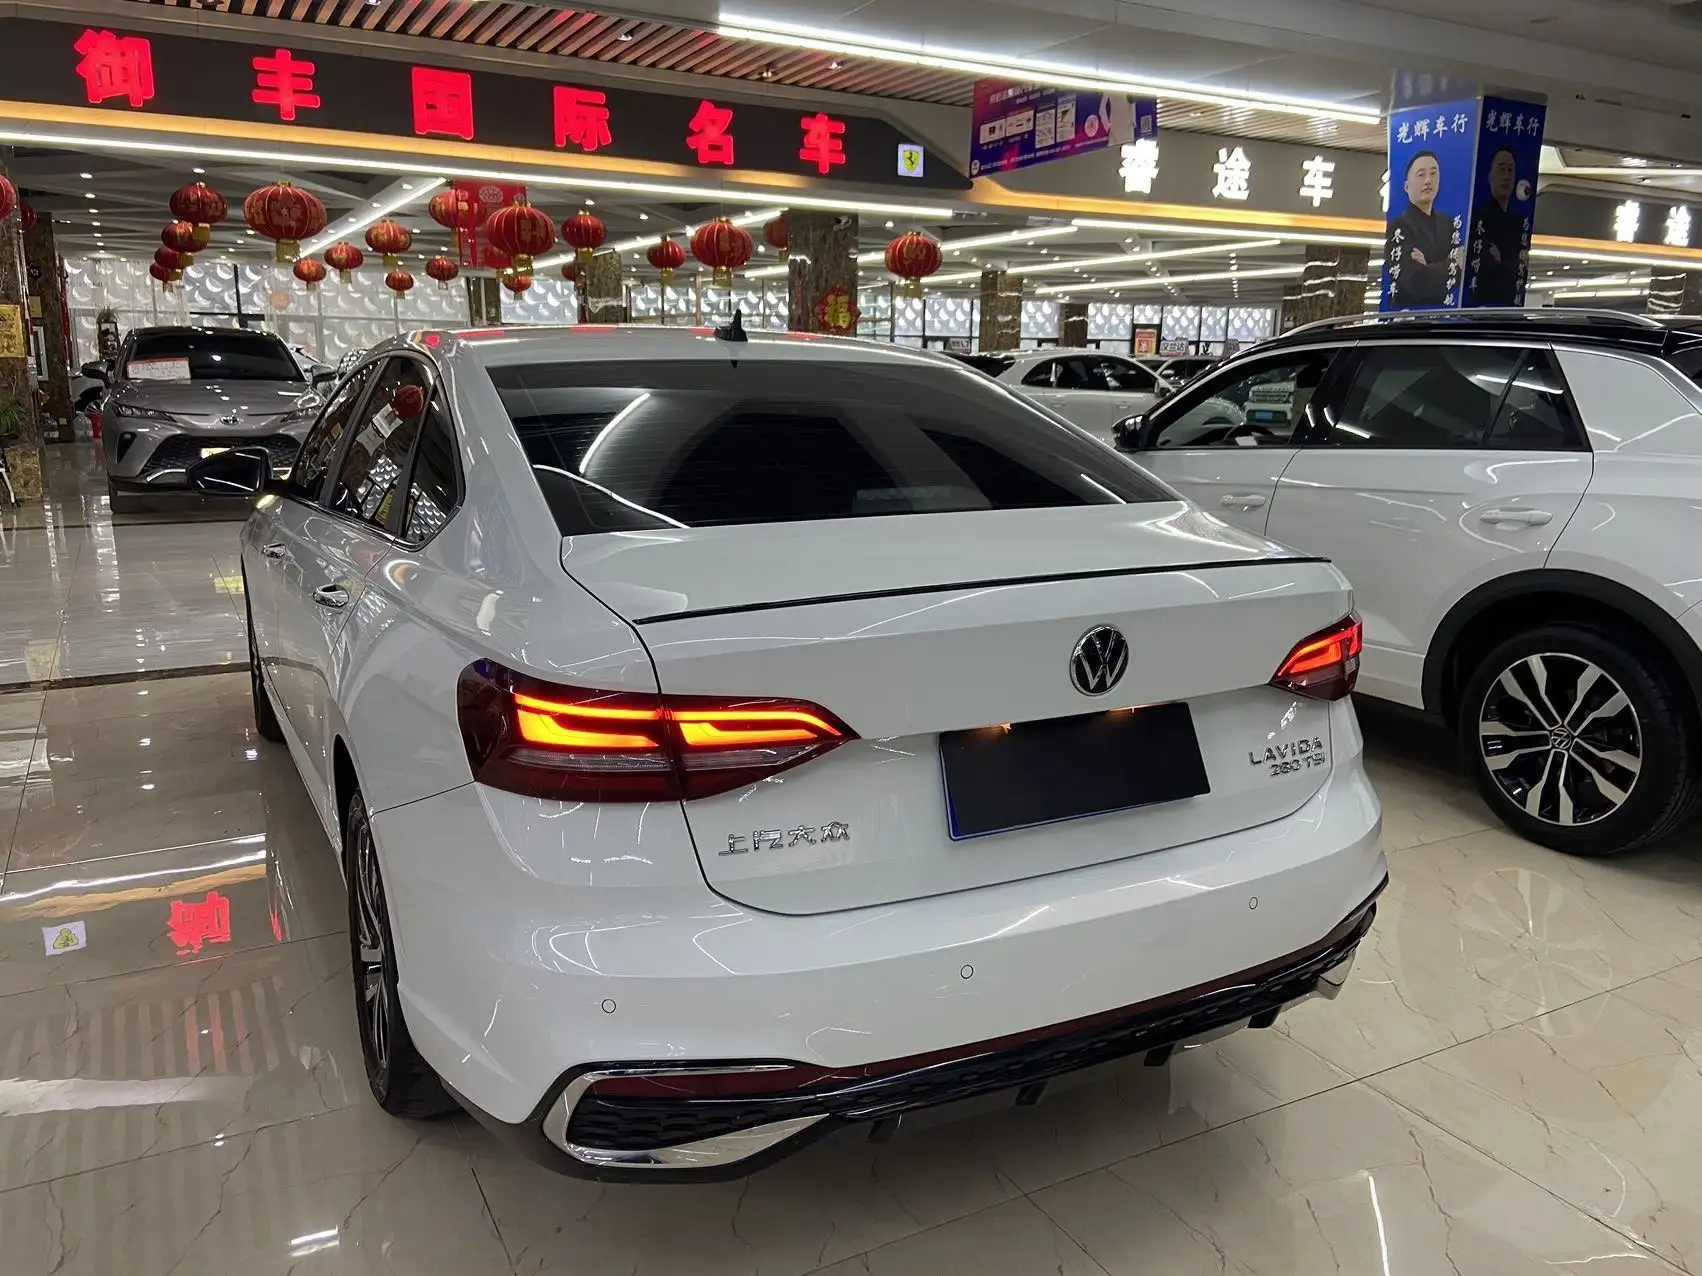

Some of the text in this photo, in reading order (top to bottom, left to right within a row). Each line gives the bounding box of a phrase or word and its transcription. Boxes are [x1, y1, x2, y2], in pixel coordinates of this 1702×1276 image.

[73, 28, 846, 174] 御丰国际名车
[1397, 113, 1468, 143] 光辉车行
[1118, 138, 1390, 212] 睿途车
[825, 295, 852, 328] 福
[1248, 736, 1323, 765] LAVIDA
[718, 821, 850, 856] 上汽大众
